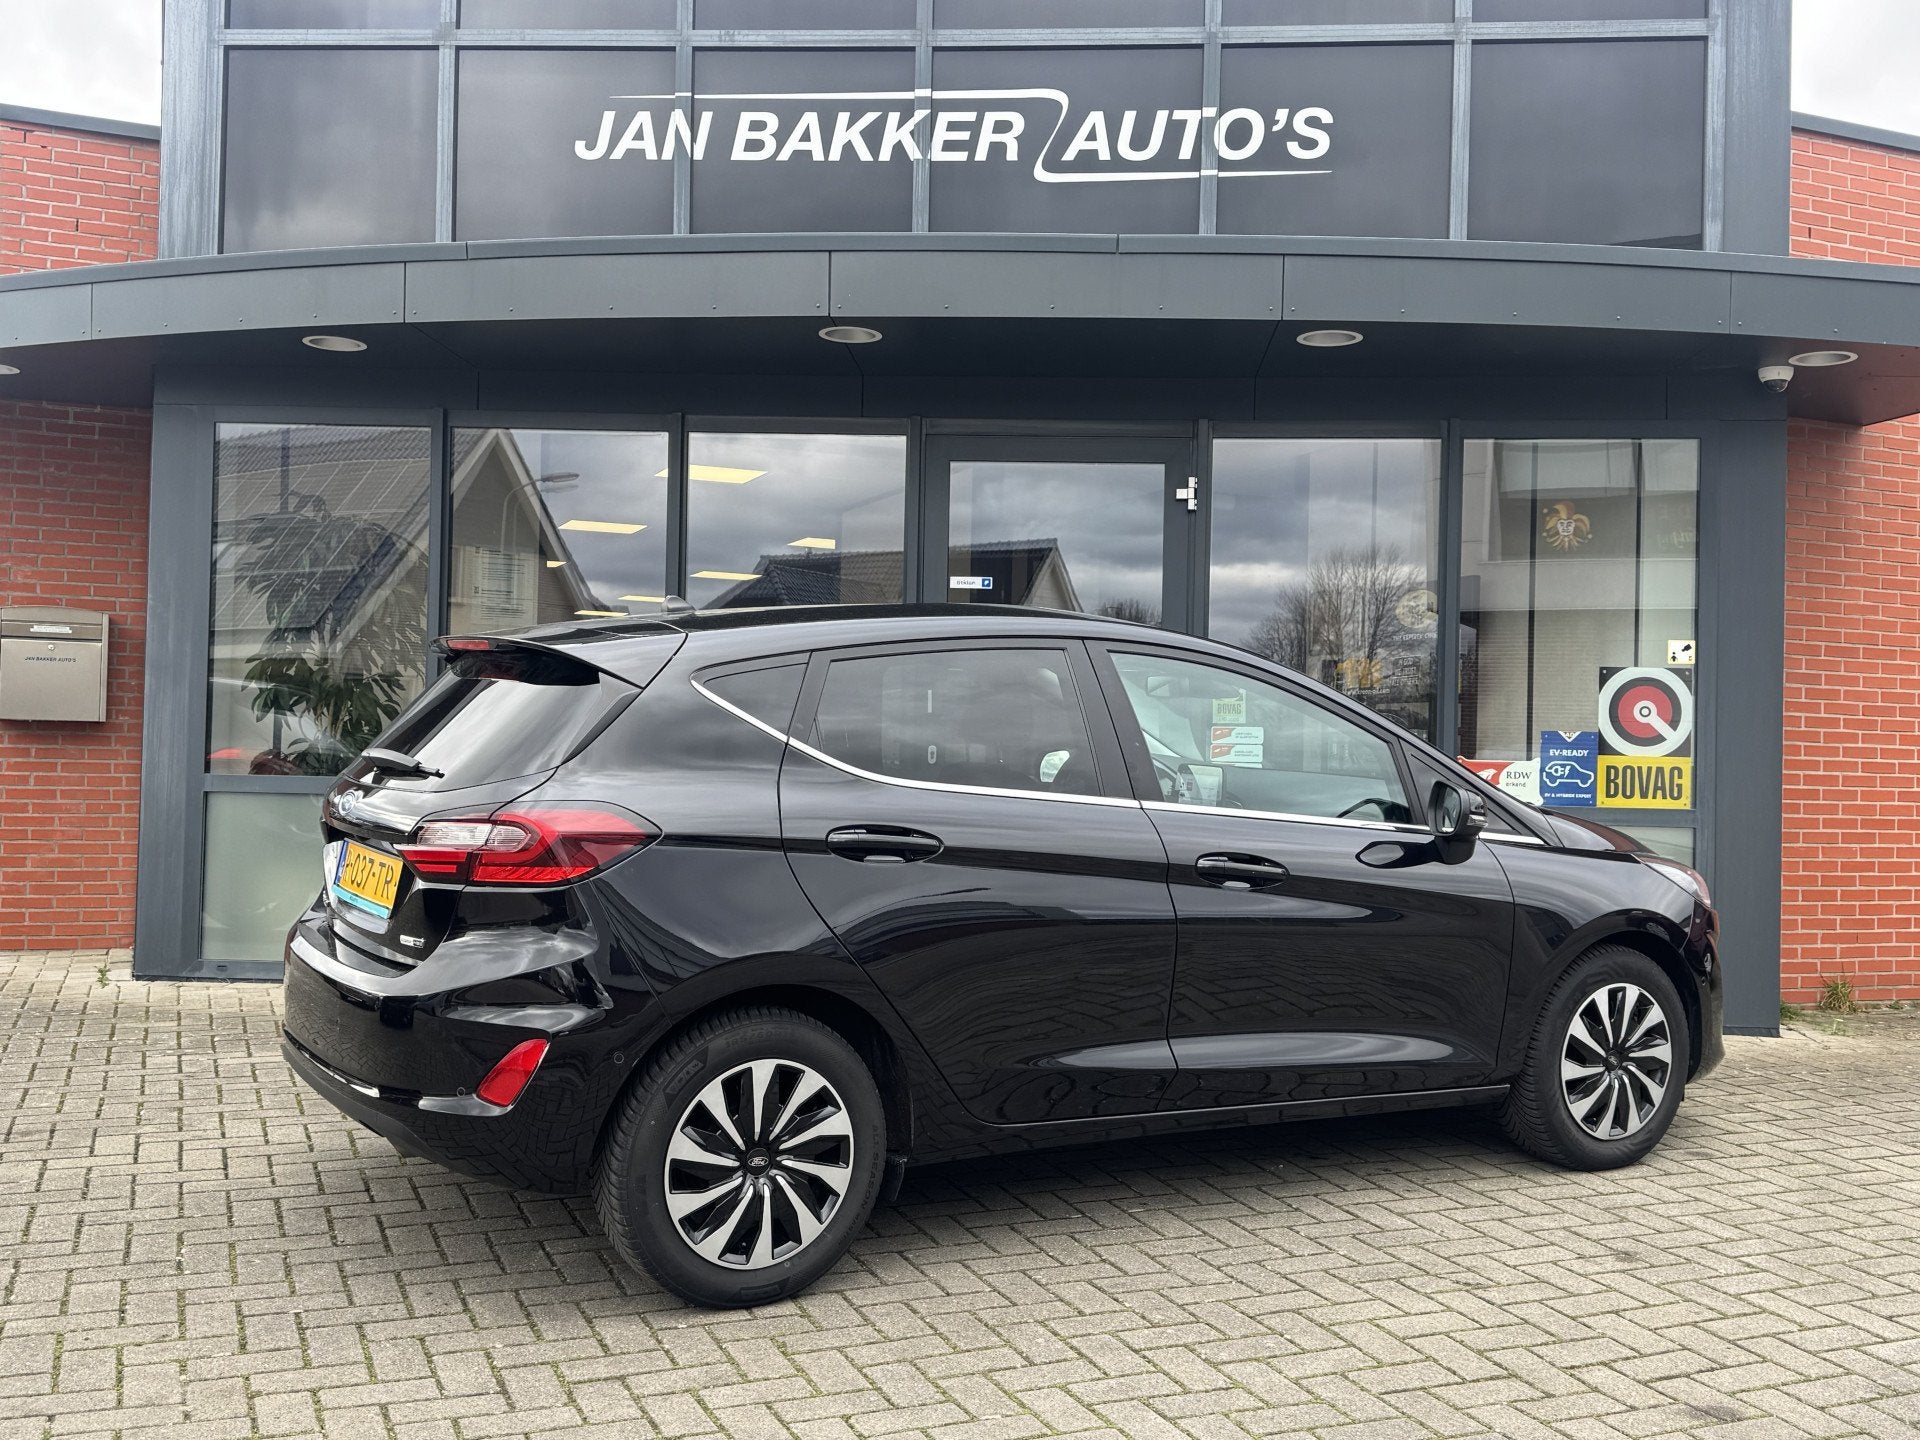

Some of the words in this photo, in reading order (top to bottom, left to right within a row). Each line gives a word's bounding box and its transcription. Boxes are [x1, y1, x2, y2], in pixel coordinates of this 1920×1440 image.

[575, 110, 713, 161] JAN
[731, 110, 1025, 162] BAKKER
[1061, 106, 1334, 162] AUTO'S
[1217, 703, 1241, 715] BOVAG
[1549, 749, 1589, 757] EV-READY
[1506, 771, 1532, 780] RDW
[1605, 764, 1684, 801] BOVAG
